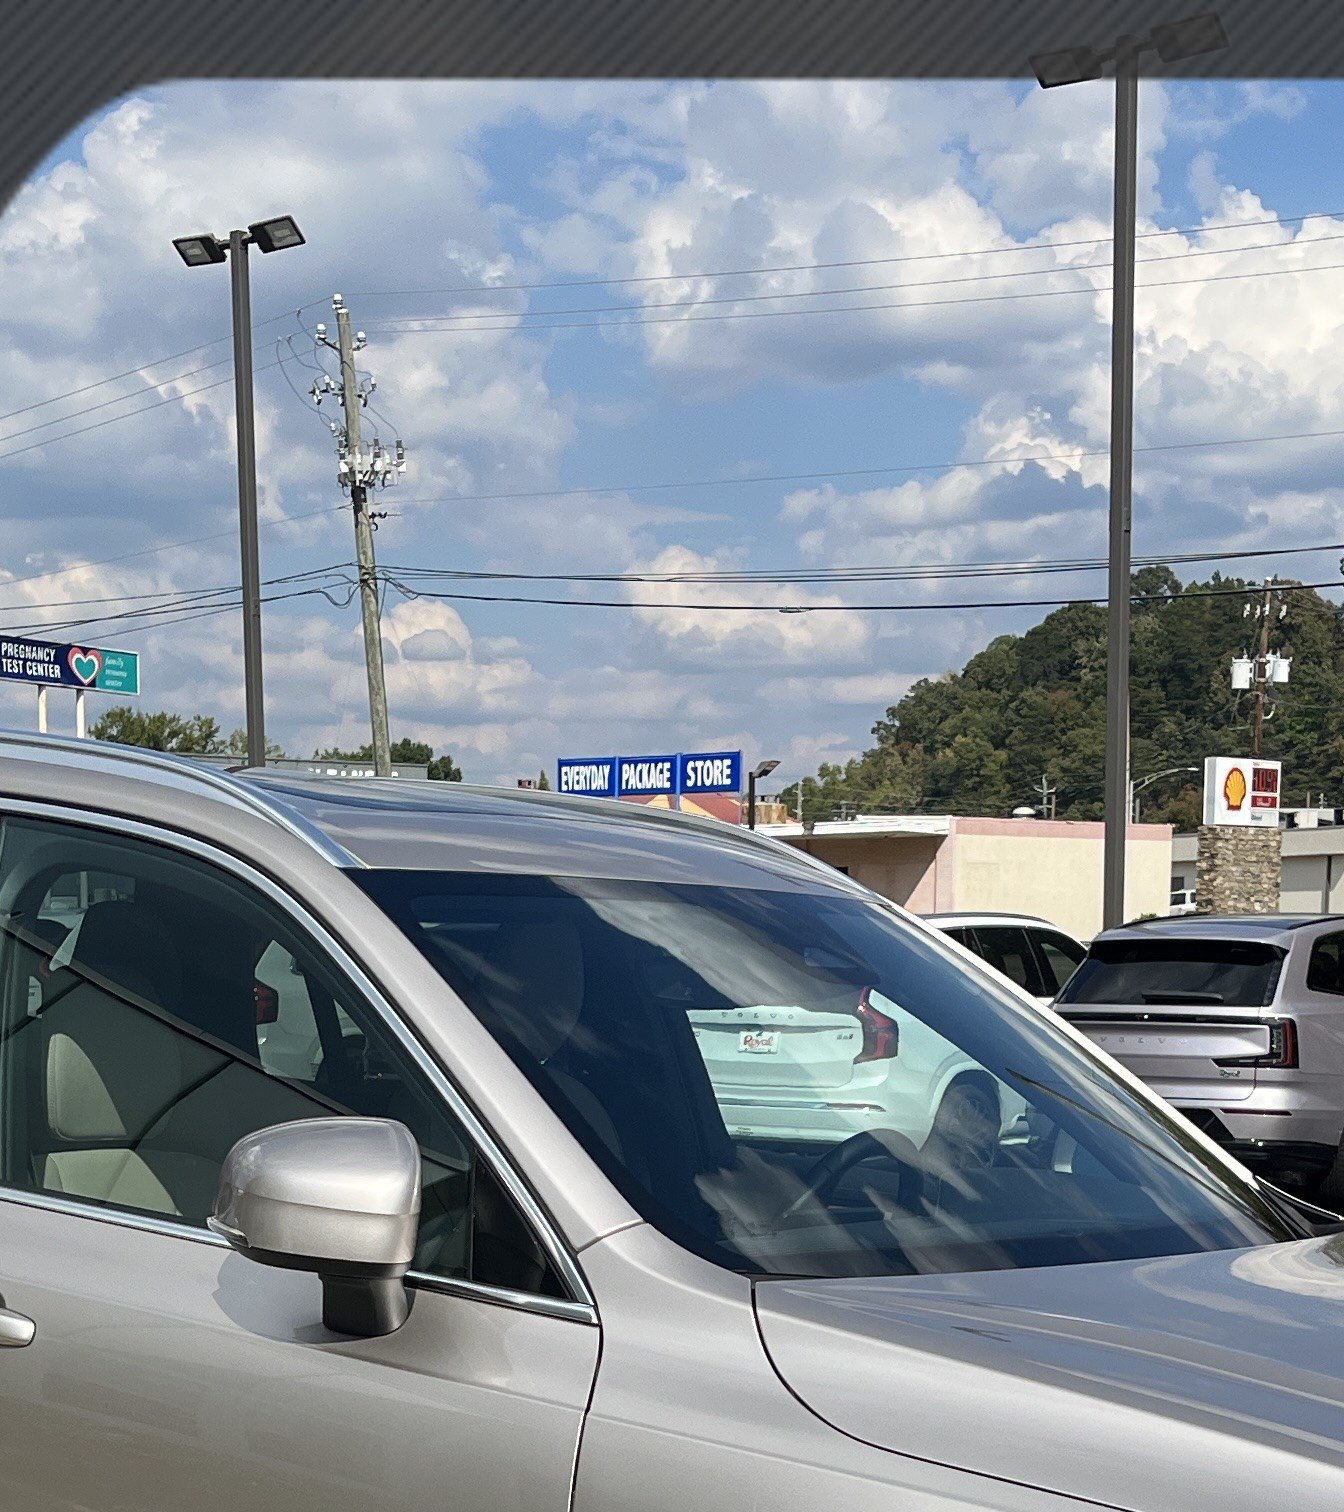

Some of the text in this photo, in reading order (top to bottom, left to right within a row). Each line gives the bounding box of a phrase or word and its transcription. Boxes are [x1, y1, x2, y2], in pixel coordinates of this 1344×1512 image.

[1, 642, 56, 662] PREGNANCY
[1, 658, 61, 678] TEST CENTER
[561, 759, 732, 791] EVERYDAY PACKAGE STORE
[743, 1035, 774, 1047] Royal
